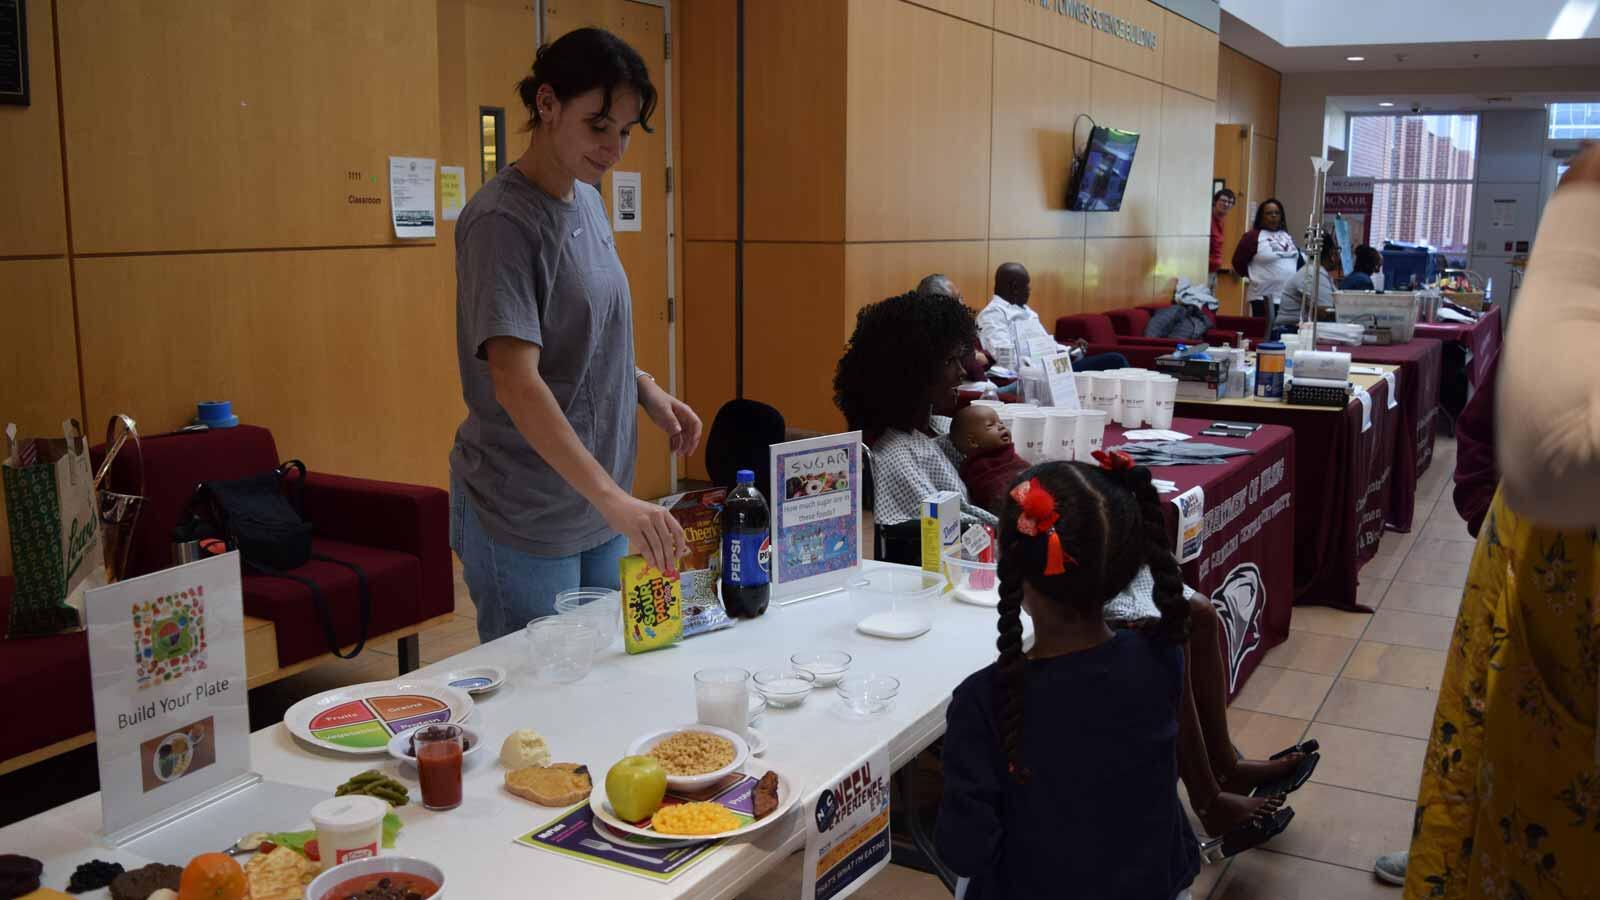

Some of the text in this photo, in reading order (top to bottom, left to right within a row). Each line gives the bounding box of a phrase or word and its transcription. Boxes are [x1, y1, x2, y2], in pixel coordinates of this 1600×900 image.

[348, 194, 382, 205] Classroom
[791, 452, 847, 474] SUGAR
[784, 503, 798, 513] How
[799, 499, 816, 511] much
[817, 497, 833, 510] sugar
[799, 507, 836, 521] these foods?
[731, 539, 741, 582] PEPSI
[640, 583, 656, 626] SOUR
[651, 577, 670, 624] PATCH
[118, 678, 230, 729] Build Your Plate
[387, 701, 423, 714] Grains
[324, 711, 359, 722] Fruits
[829, 776, 883, 831] EXPERIENCE
